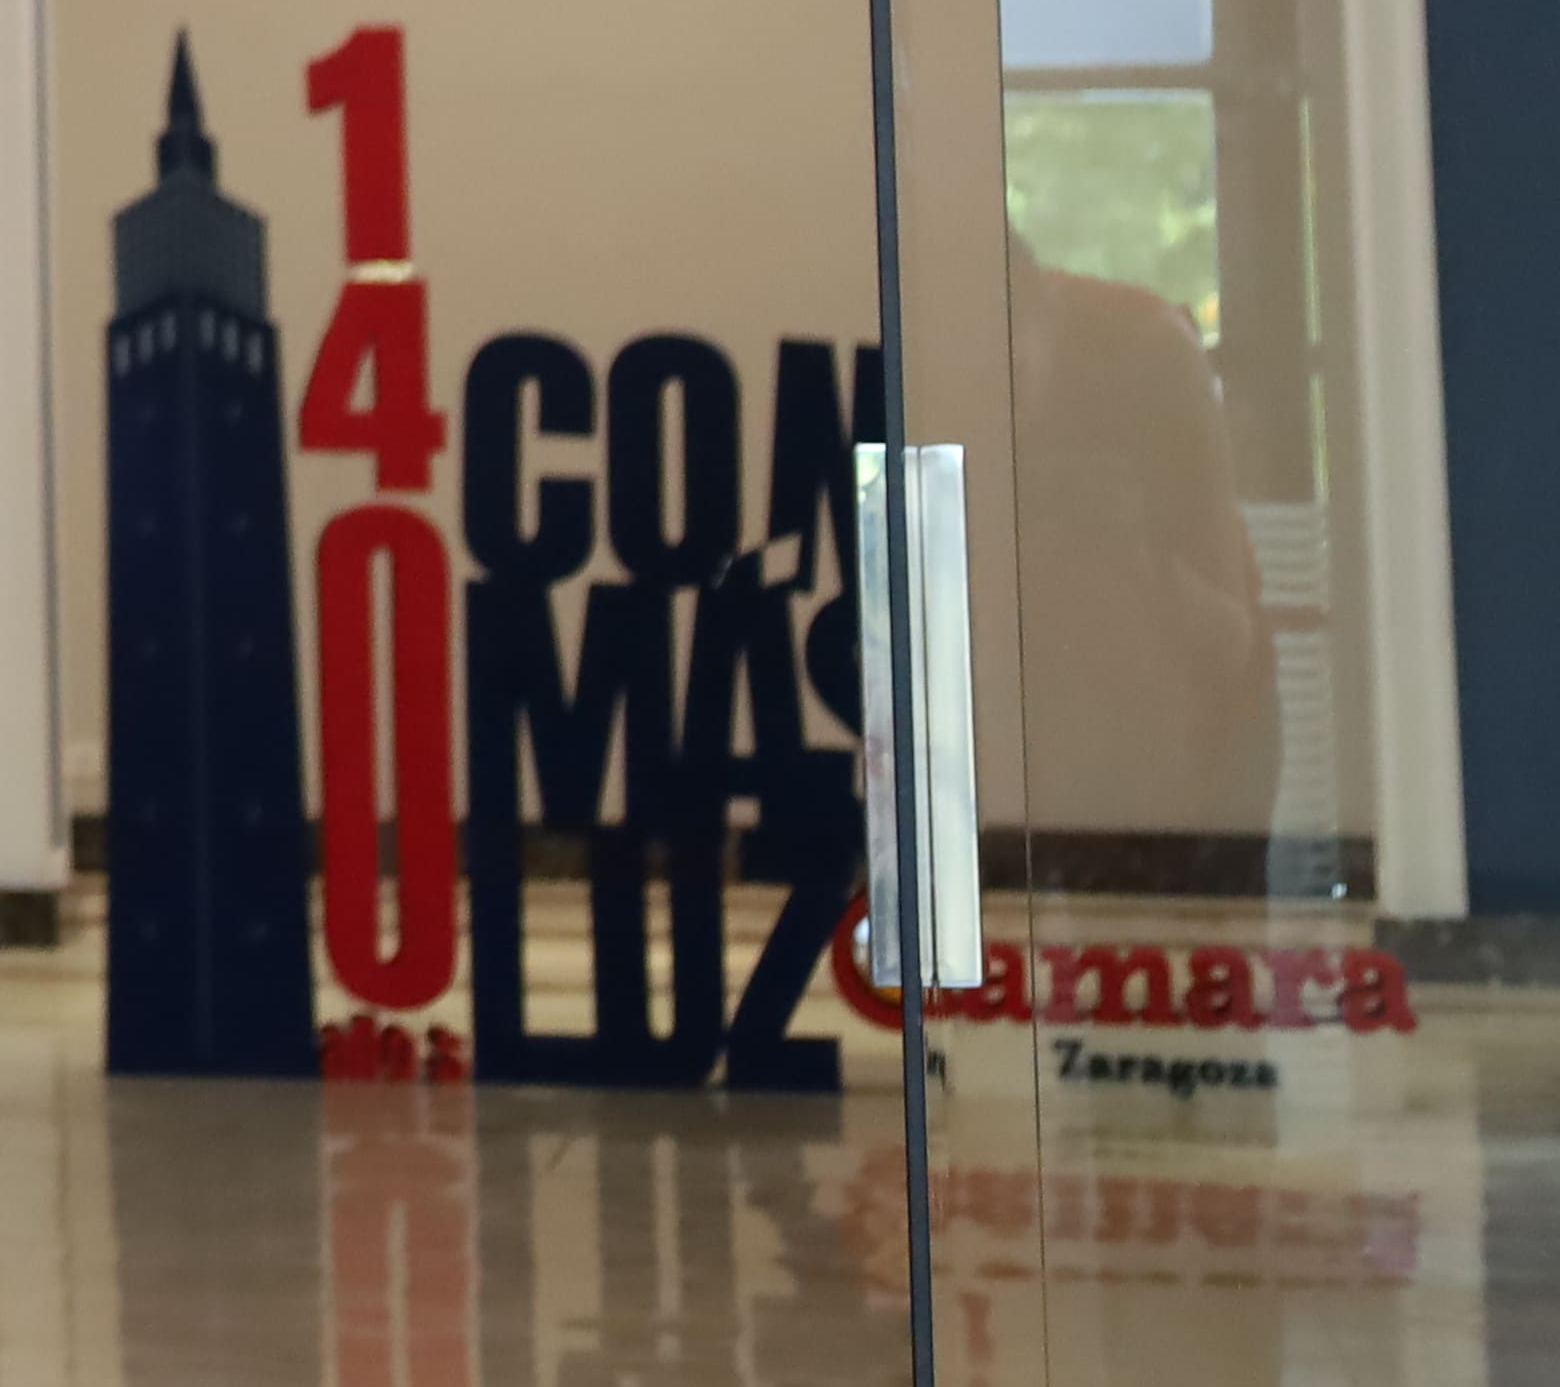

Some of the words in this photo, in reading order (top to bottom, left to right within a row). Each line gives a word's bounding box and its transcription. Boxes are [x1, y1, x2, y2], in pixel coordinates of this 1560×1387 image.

[462, 331, 885, 589] CON
[467, 819, 865, 1093] LUZ
[1051, 1035, 1280, 1099] Zaragoza
